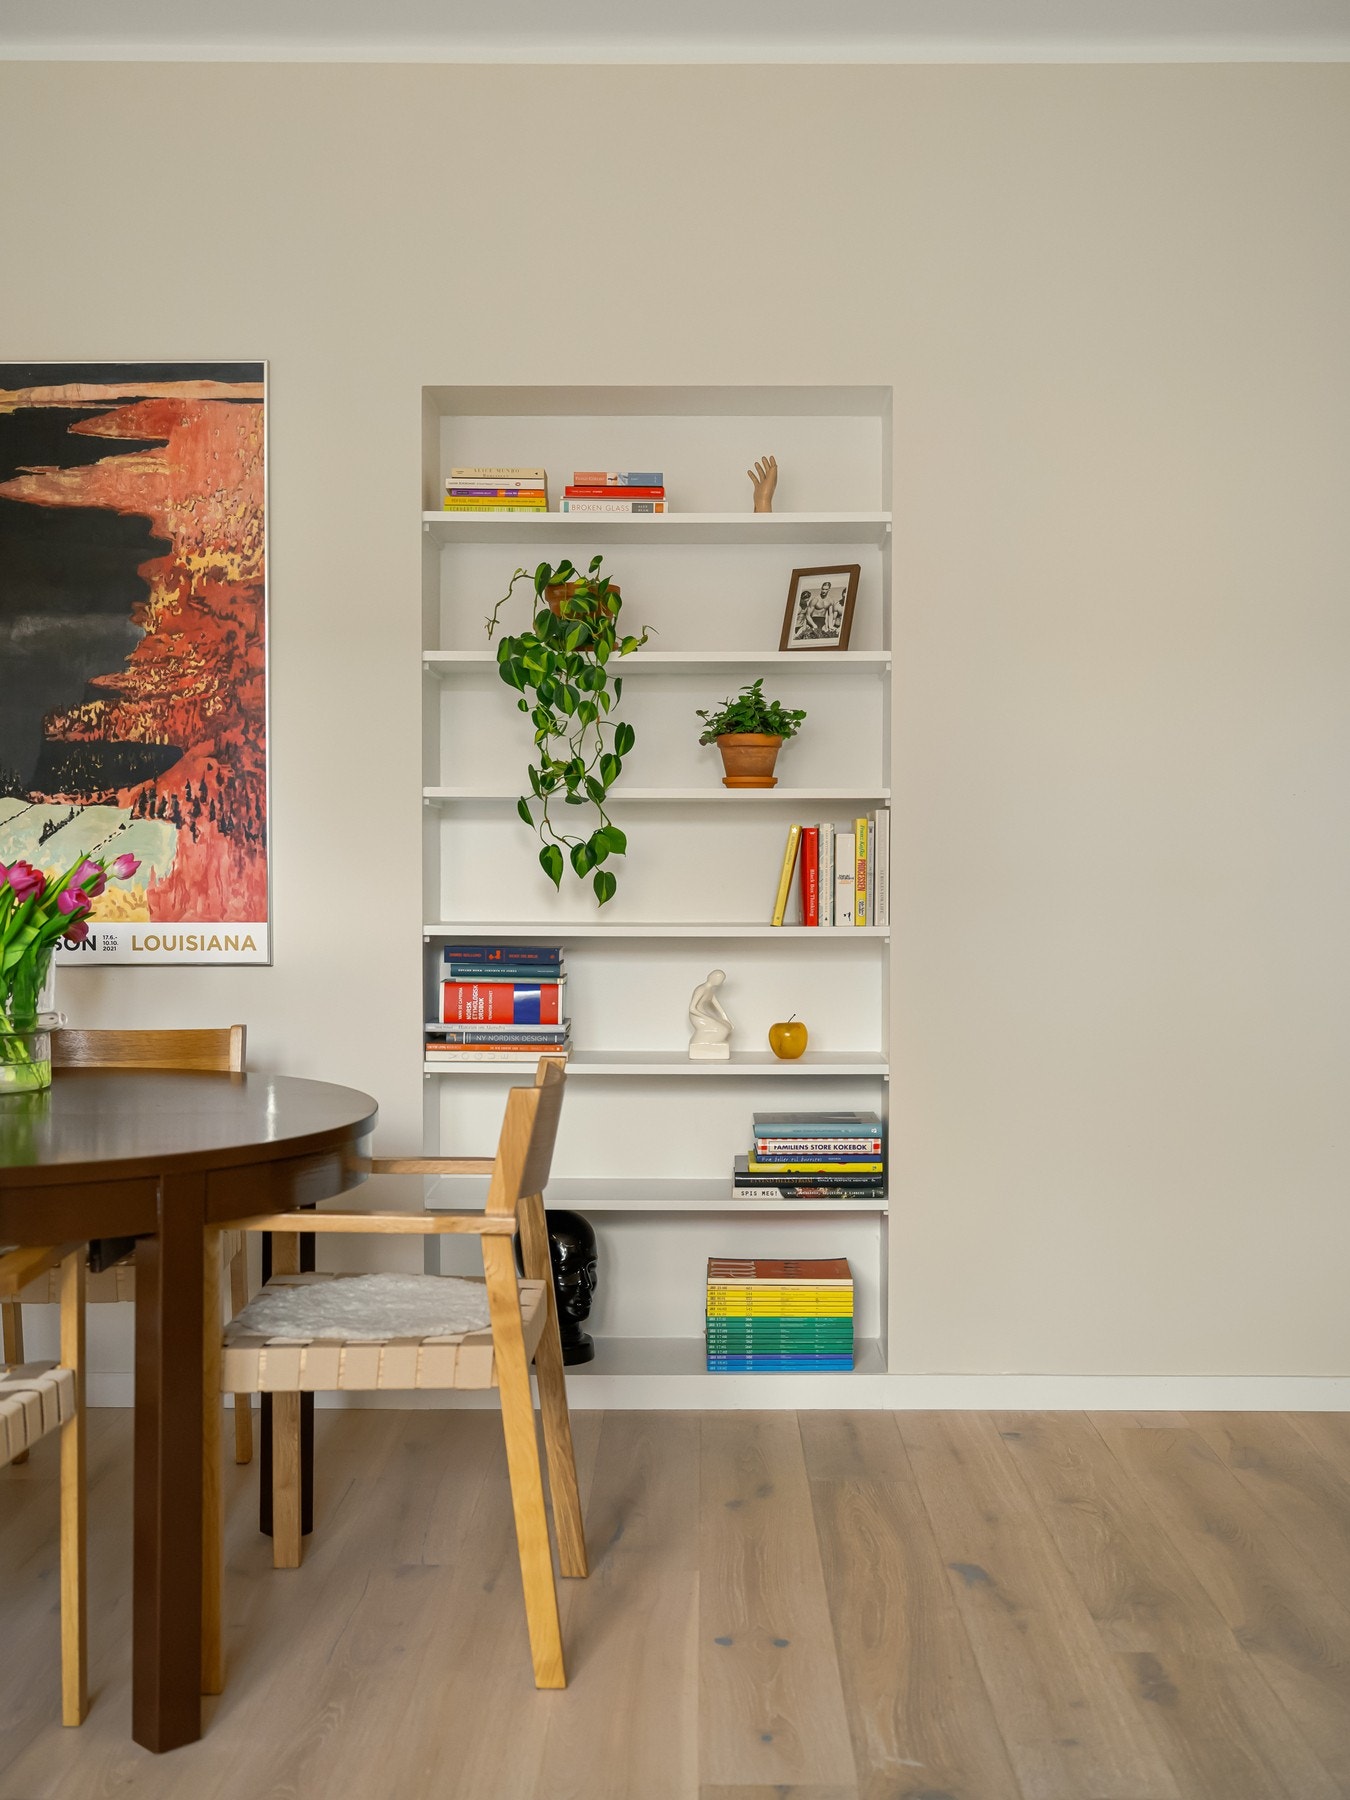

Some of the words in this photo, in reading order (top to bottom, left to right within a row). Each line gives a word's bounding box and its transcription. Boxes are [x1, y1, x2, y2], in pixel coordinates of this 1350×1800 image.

[605, 504, 630, 512] GLASS
[858, 859, 866, 892] PROCESSEN
[131, 935, 257, 951] LOUISIANA
